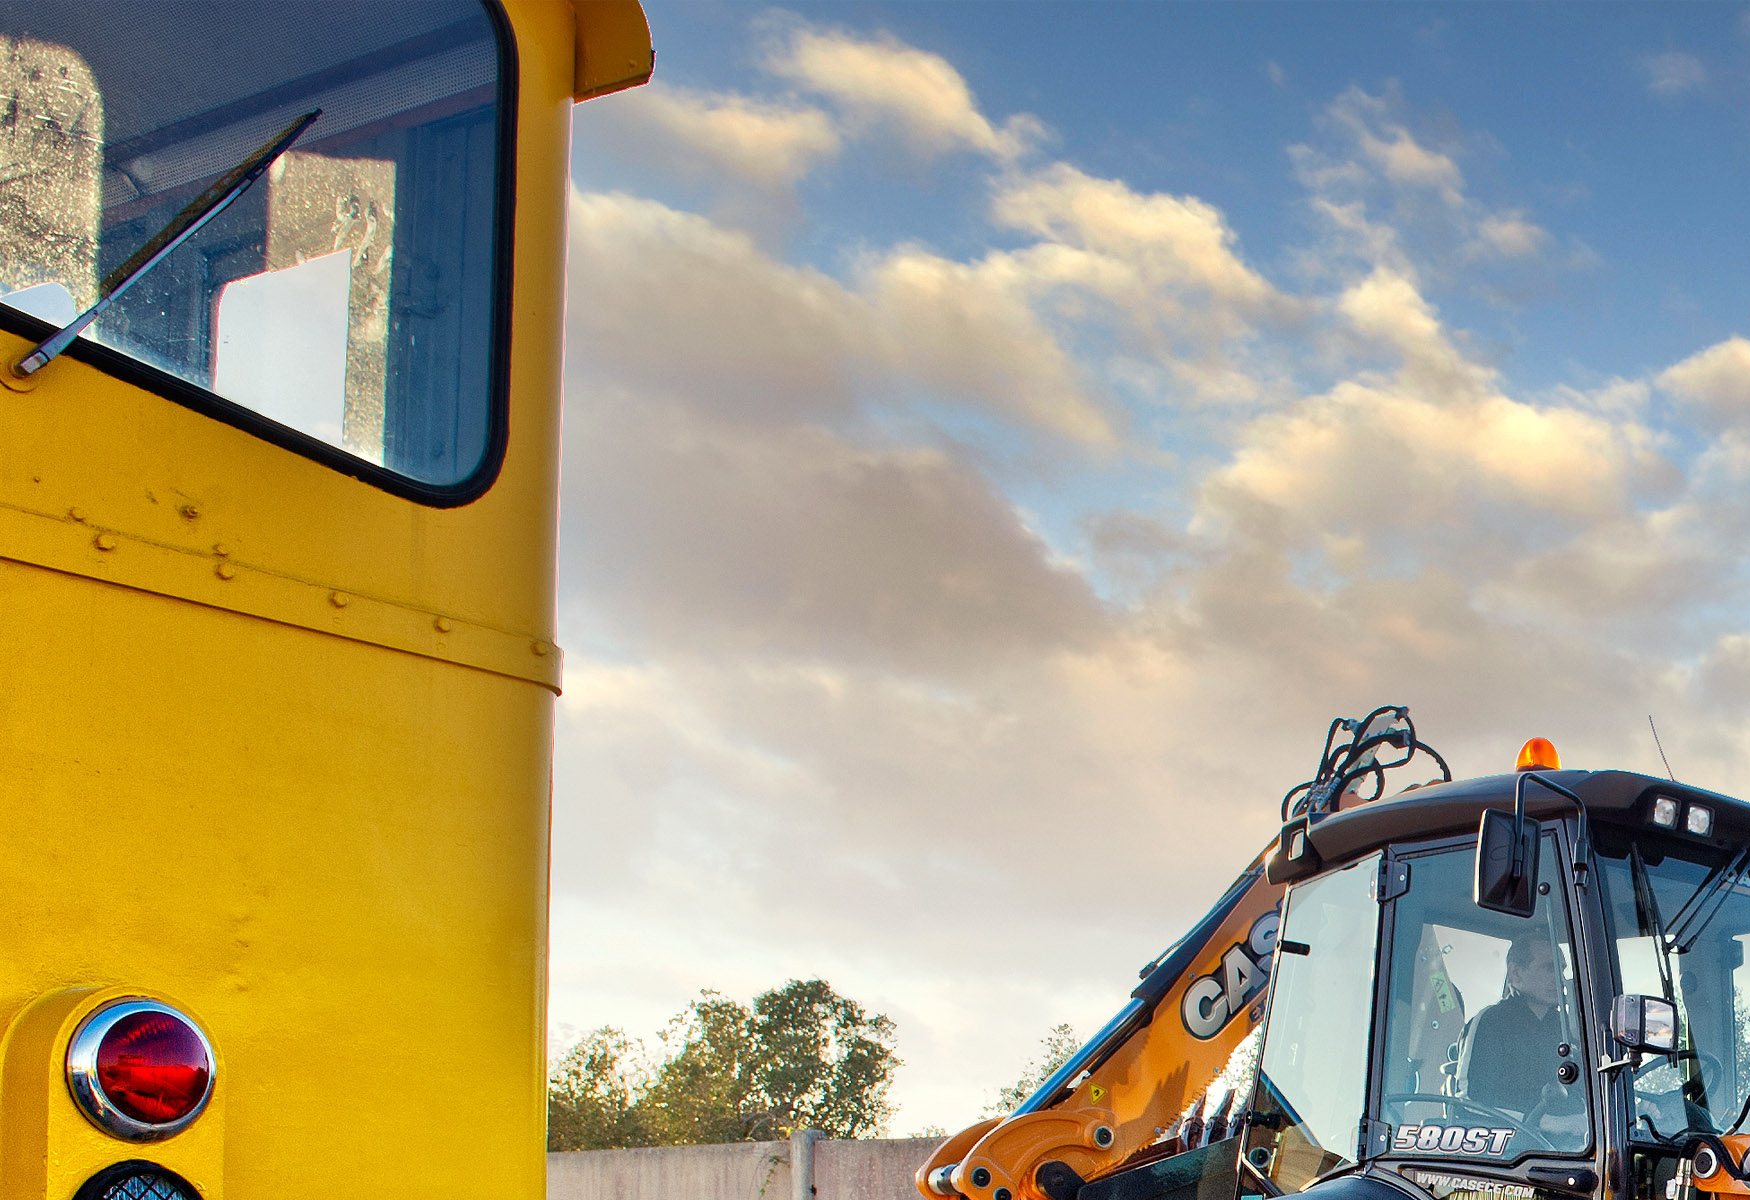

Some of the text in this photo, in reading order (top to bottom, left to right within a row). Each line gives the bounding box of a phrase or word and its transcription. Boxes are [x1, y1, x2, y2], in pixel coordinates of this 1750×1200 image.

[1182, 910, 1281, 1039] CAS
[1393, 1125, 1517, 1155] 580ST
[1416, 1172, 1535, 1199] WWW.CASECE.COM
